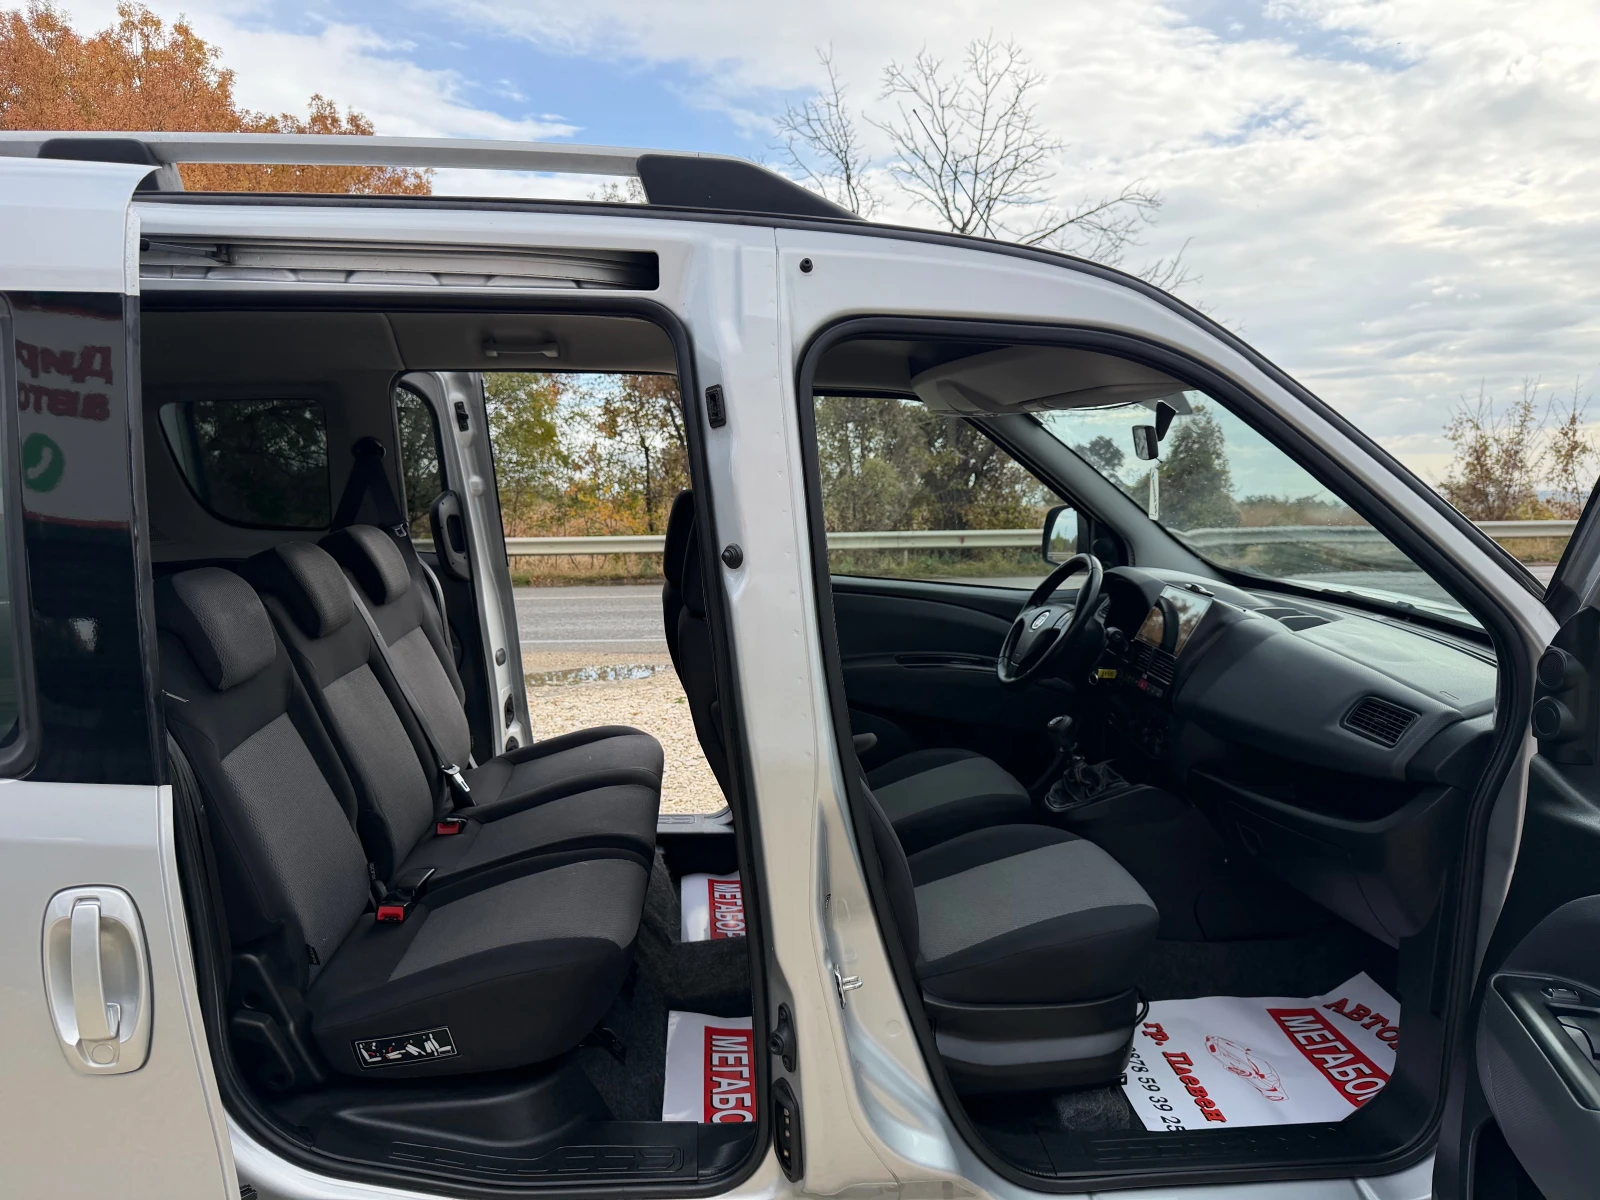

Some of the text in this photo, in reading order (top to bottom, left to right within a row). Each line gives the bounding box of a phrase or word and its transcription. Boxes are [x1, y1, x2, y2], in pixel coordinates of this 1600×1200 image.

[1129, 1046, 1149, 1073] 878
[1138, 1076, 1161, 1092] 59
[1149, 1095, 1173, 1112] 39
